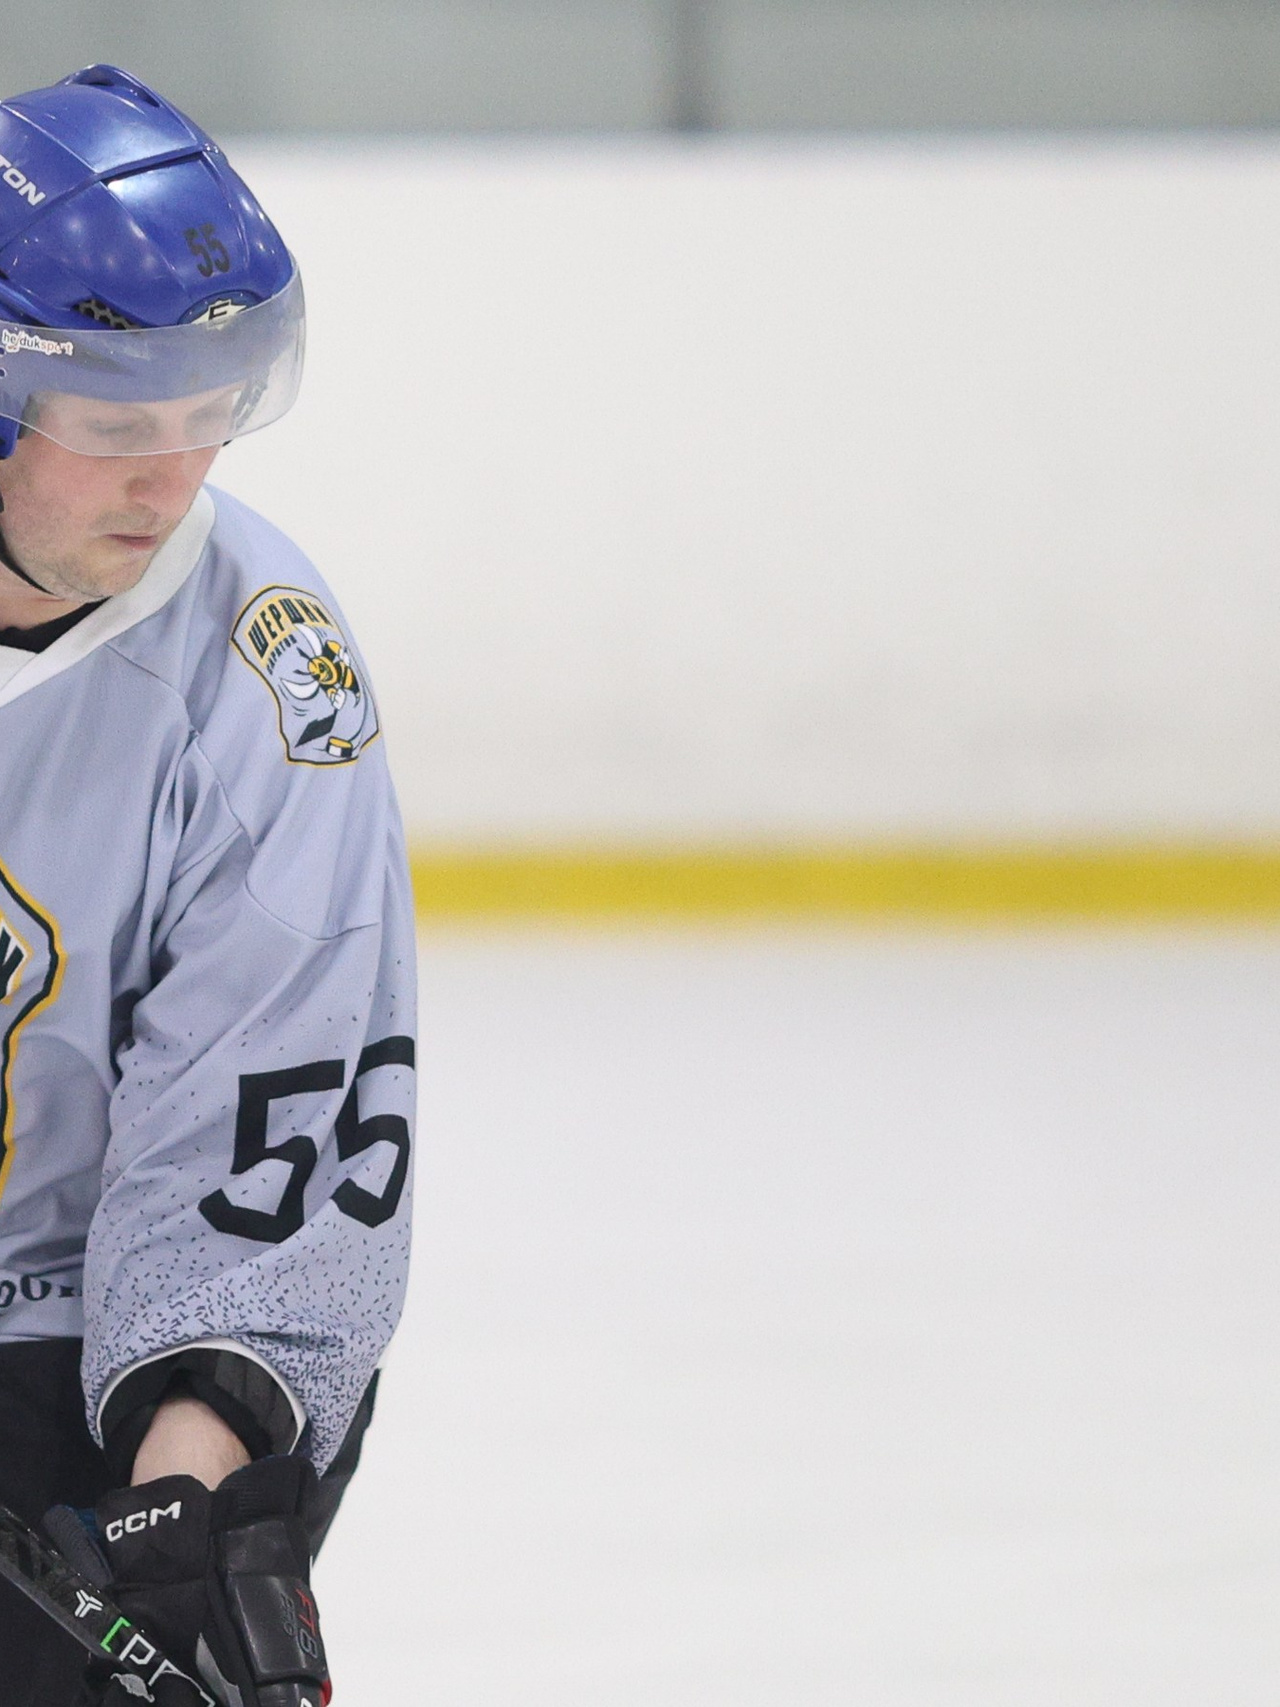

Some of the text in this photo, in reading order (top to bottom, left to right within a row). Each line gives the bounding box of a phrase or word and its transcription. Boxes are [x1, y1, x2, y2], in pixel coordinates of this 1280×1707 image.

[183, 221, 231, 278] 55
[197, 1035, 416, 1244] 55
[105, 1500, 182, 1542] CCM
